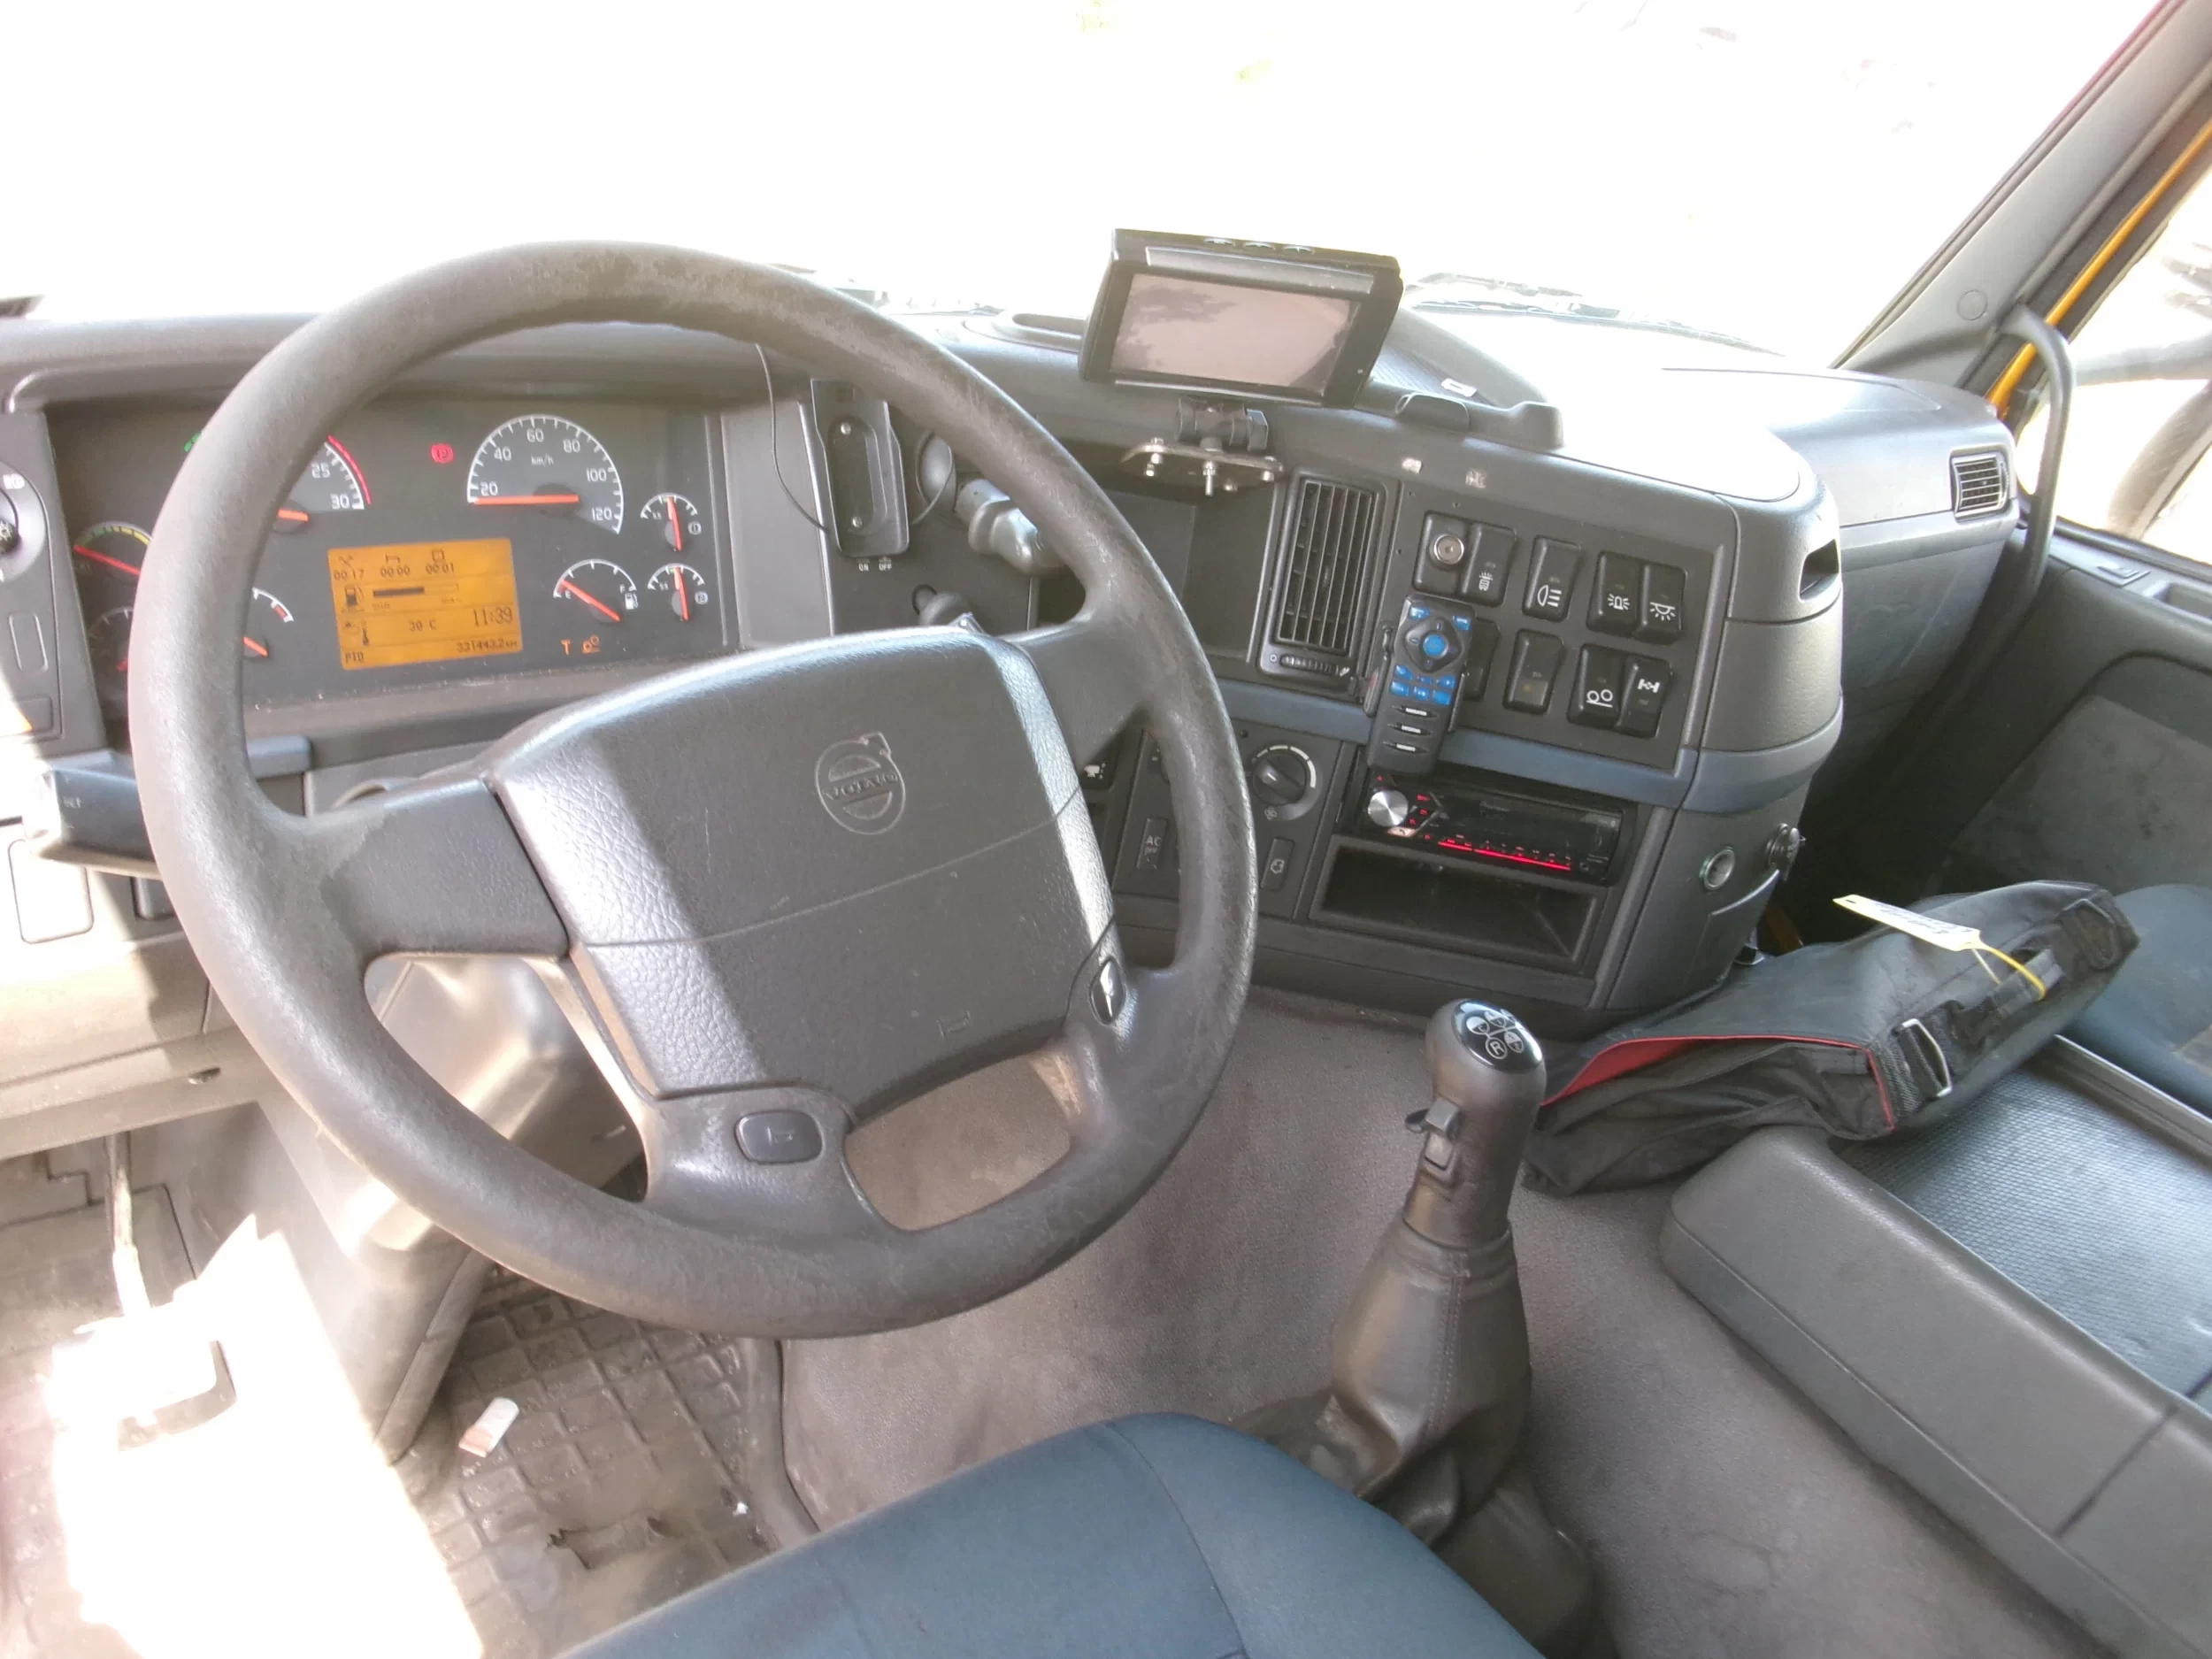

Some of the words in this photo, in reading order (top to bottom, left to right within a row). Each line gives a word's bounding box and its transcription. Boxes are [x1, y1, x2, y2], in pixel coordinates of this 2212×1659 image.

[526, 428, 544, 442] 60
[563, 439, 580, 453] 80
[494, 447, 511, 462] 40
[531, 454, 554, 466] km/h
[311, 462, 331, 479] 25
[587, 468, 607, 482] 100
[480, 481, 498, 496] 20
[330, 494, 349, 510] 30
[592, 507, 612, 521] 120
[858, 562, 870, 572] ON
[879, 562, 893, 571] OFF
[473, 606, 513, 627] 11:39
[1145, 835, 1162, 847] AC
[1489, 1040, 1506, 1056] R
